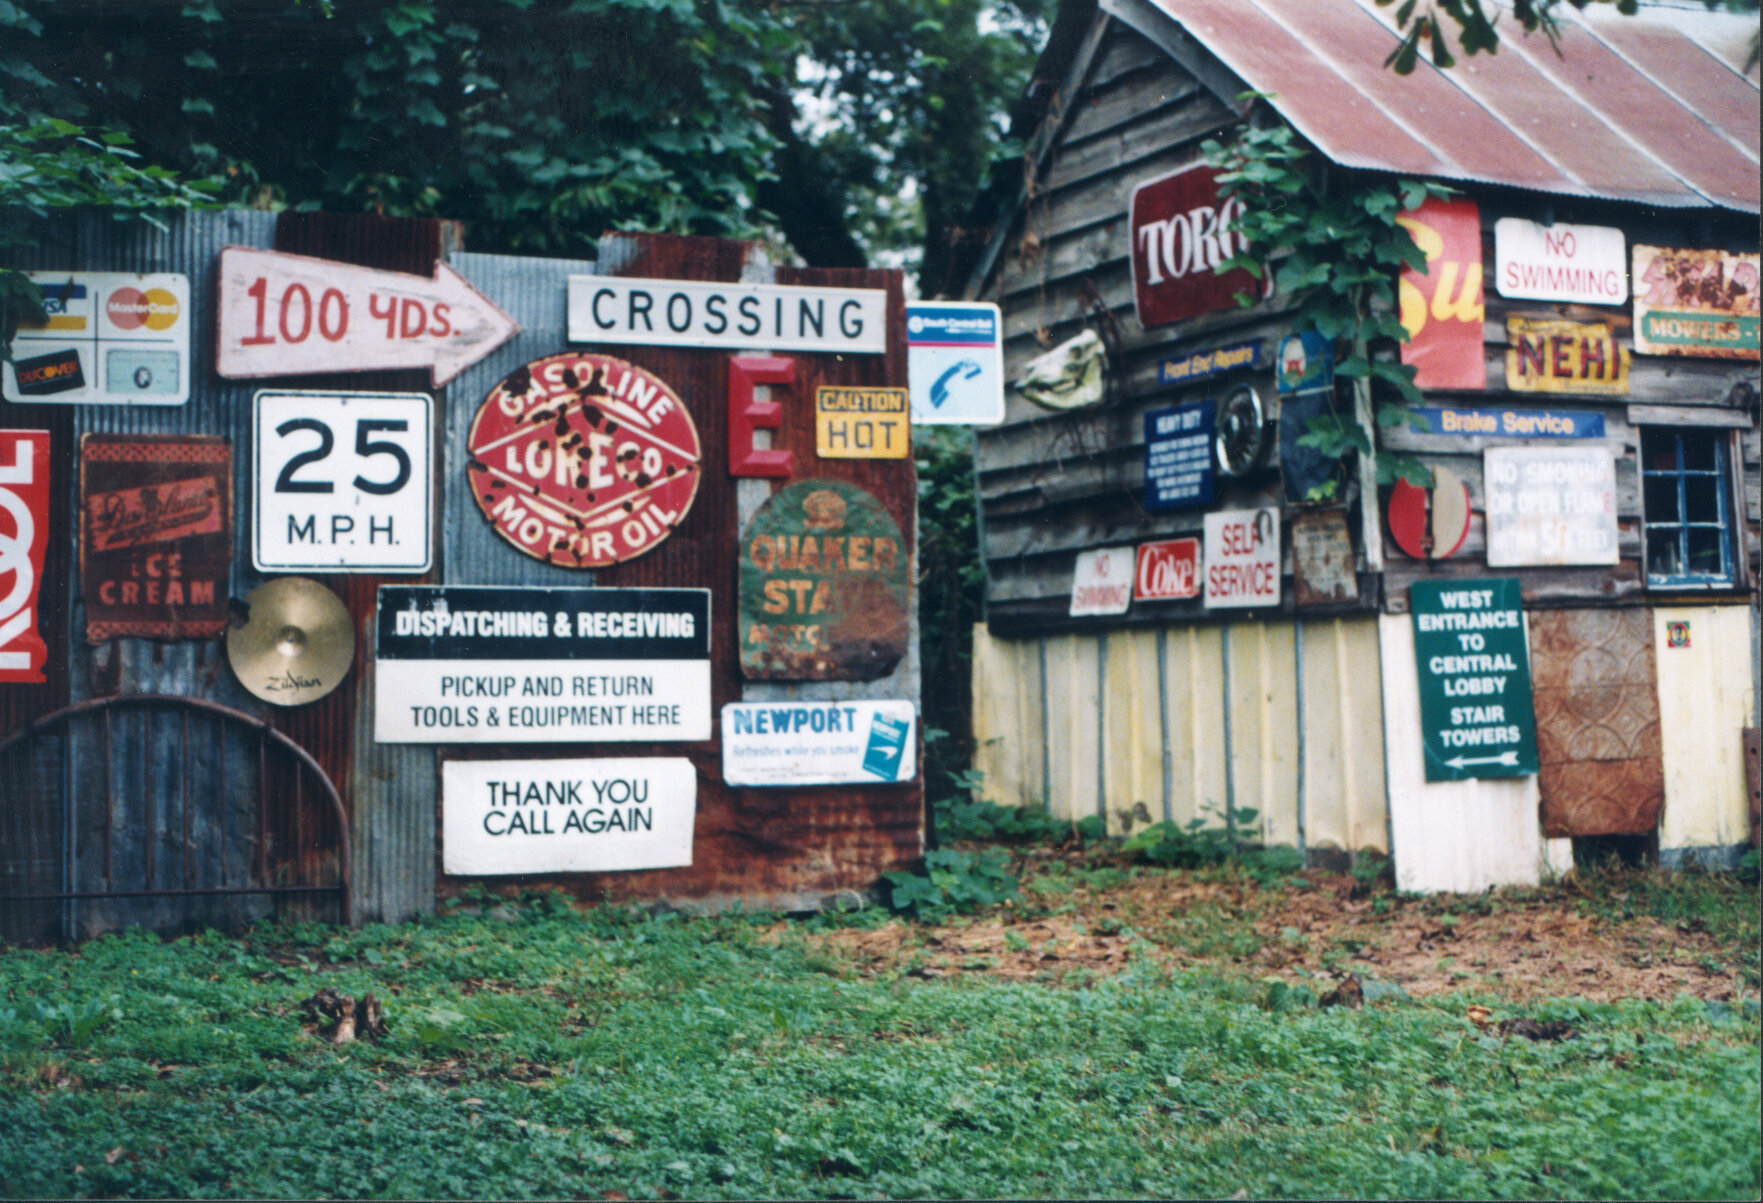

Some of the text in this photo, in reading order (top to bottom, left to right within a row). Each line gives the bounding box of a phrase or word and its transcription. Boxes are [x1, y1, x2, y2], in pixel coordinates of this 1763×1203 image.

[1546, 231, 1576, 259] NO
[1506, 261, 1618, 296] SWIMMING
[107, 301, 179, 315] MasterCard
[241, 277, 349, 346] 100
[592, 289, 864, 338] CROSSING
[1648, 317, 1741, 341] MOWERS
[1517, 334, 1619, 380] NEHI
[498, 361, 675, 426] GASOLINE
[822, 391, 901, 411] CAUTION
[729, 356, 795, 477] E
[1441, 410, 1575, 434] Brake Service
[828, 421, 897, 449] HOT
[275, 418, 411, 496] 25
[493, 495, 677, 560] MOTOR OIL
[750, 534, 898, 573] QUAKER
[1140, 546, 1193, 596] Coke
[1210, 561, 1274, 597] SERVICE
[100, 580, 215, 605] CREAM
[1440, 591, 1494, 609] WEST
[396, 611, 695, 638] DISPATCHING & RECEIVING
[1418, 611, 1520, 631] ENTRANCE
[1458, 633, 1486, 651] TO
[1429, 654, 1518, 675] CENTRAL
[441, 676, 654, 697] PICKUP AND RETURN
[1443, 677, 1507, 697] LOBBY
[411, 704, 681, 727] TOOLS & EQUIPMENT HERE
[733, 707, 857, 734] NEWPORT
[1450, 706, 1506, 726] STAIR
[1440, 726, 1521, 748] TOWERS
[486, 779, 648, 806] THANK YOU
[483, 807, 653, 836] CALL AGAIN
